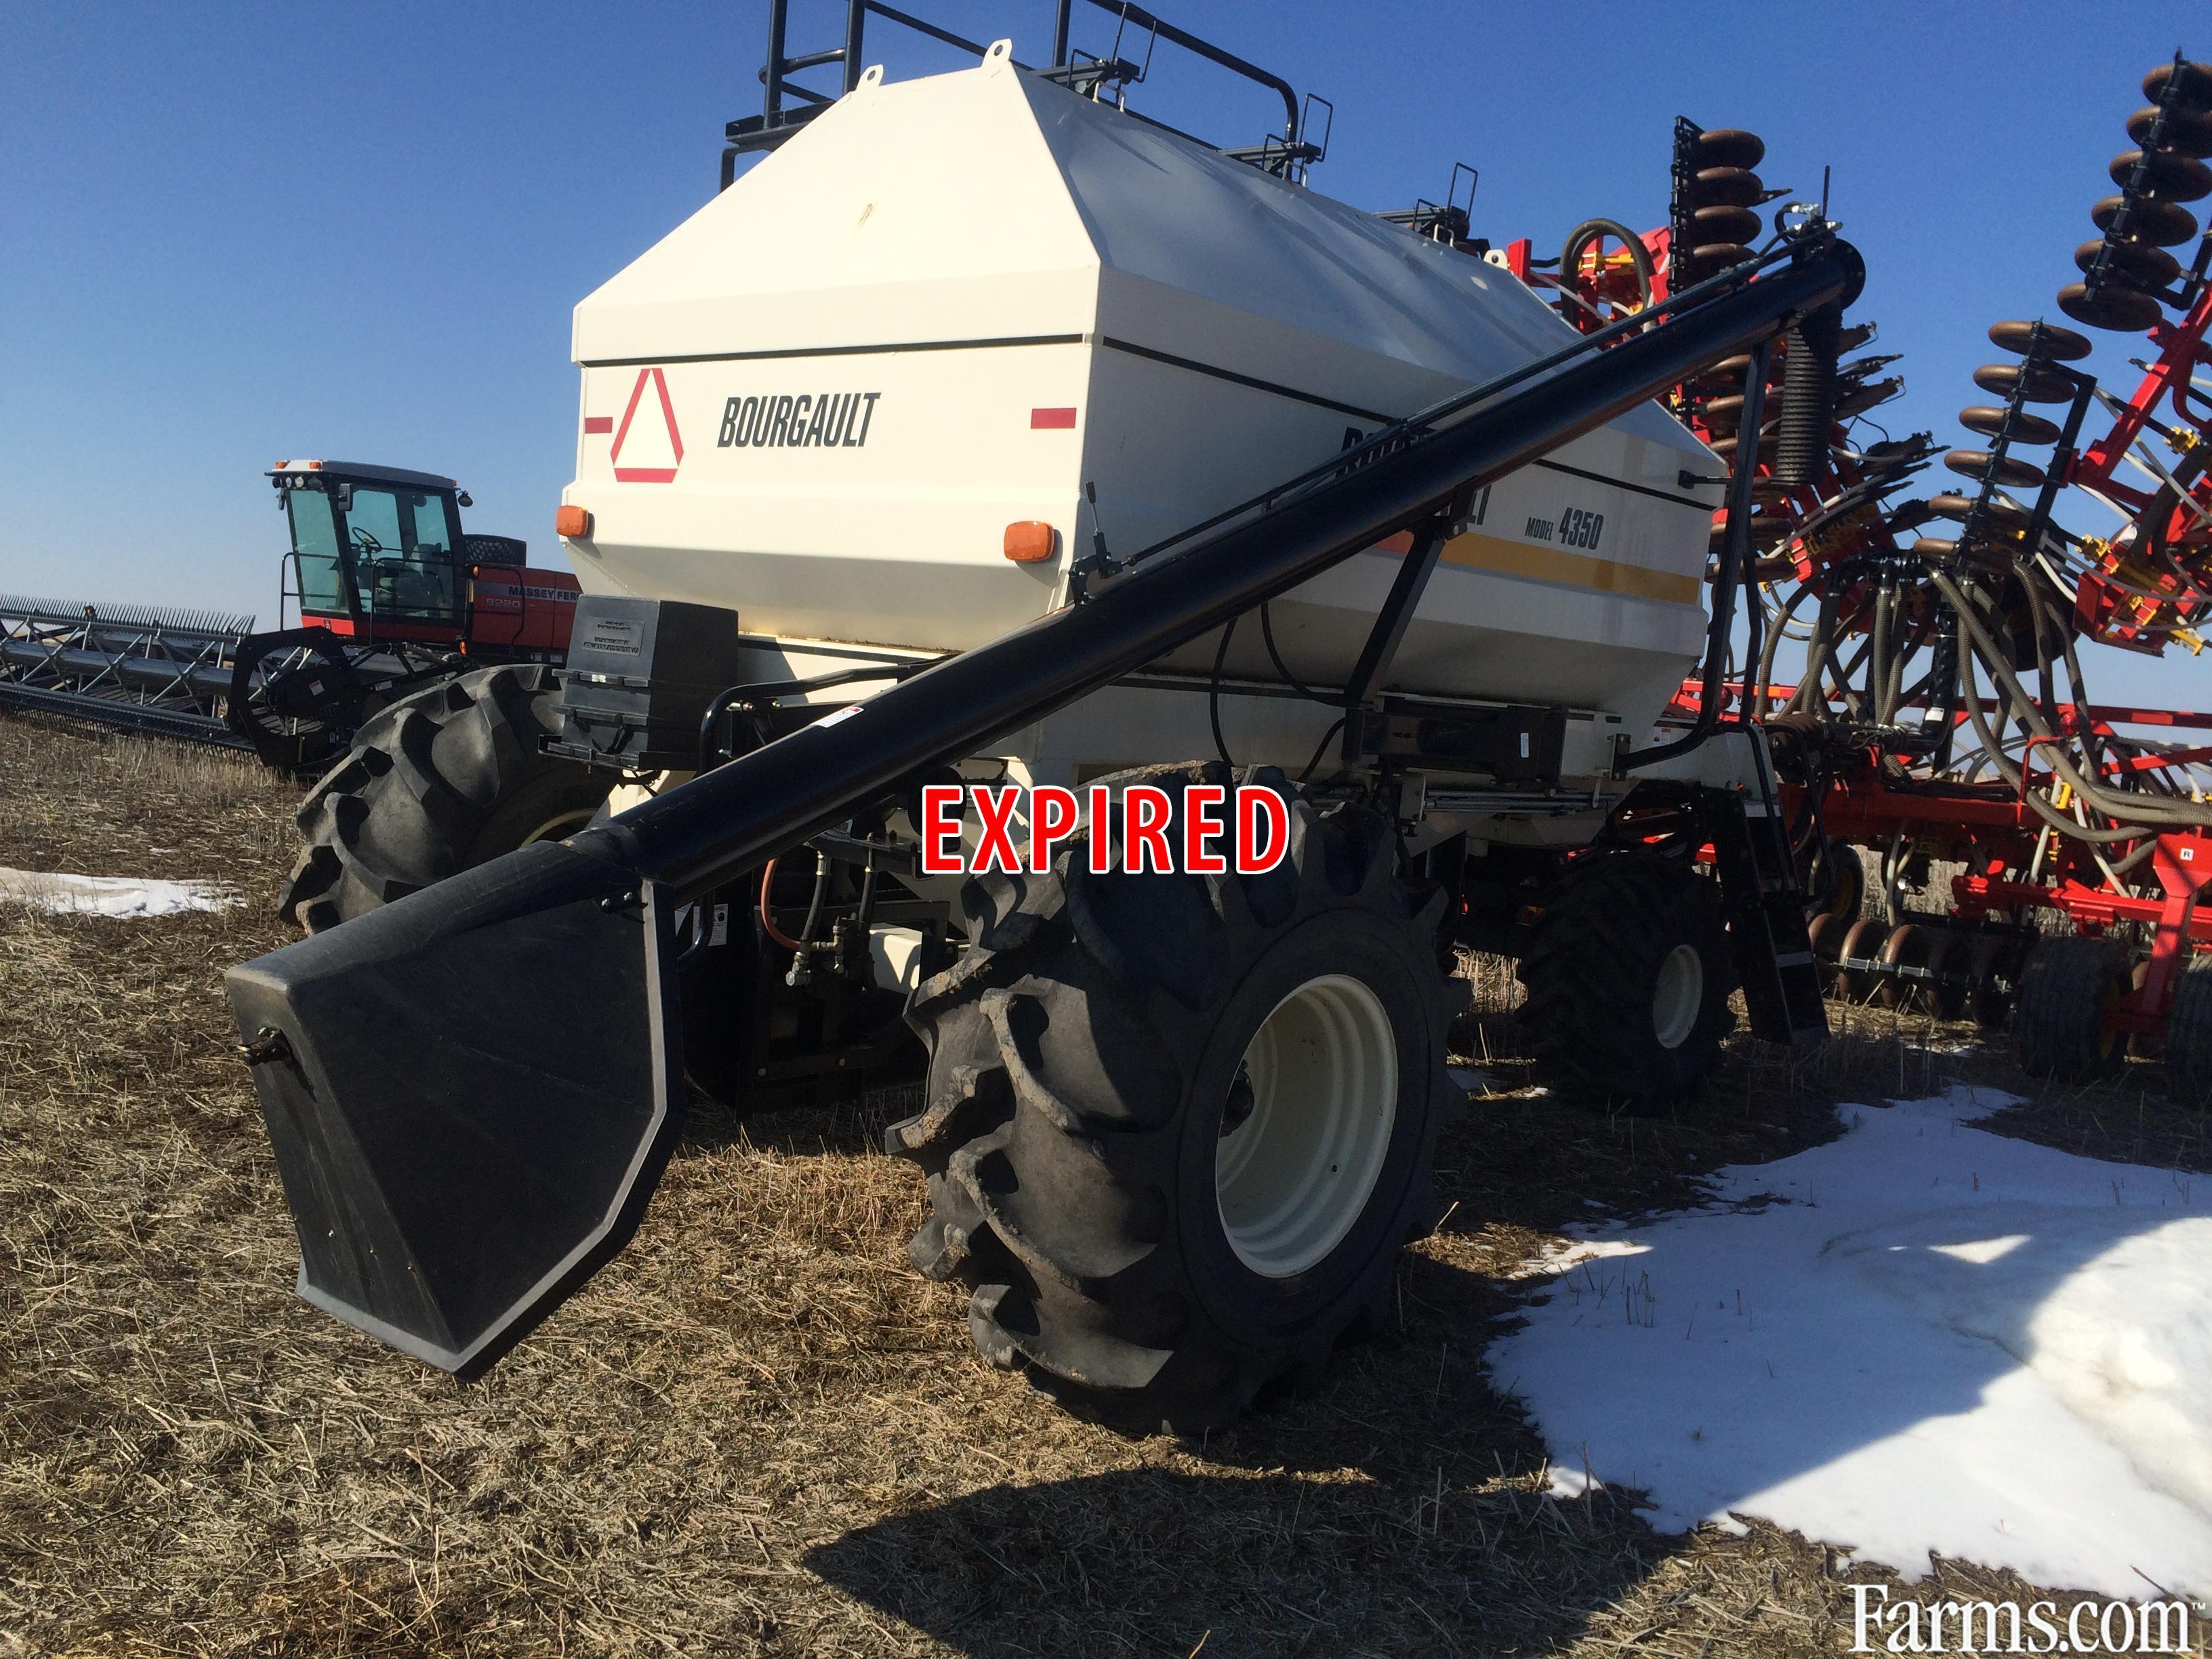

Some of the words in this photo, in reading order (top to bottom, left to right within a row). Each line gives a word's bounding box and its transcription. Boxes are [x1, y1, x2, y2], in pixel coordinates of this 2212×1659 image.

[717, 392, 881, 448] BOURGAULT
[1525, 516, 1554, 541] MODEL
[1559, 507, 1604, 550] 4350
[508, 586, 555, 599] MASSEY
